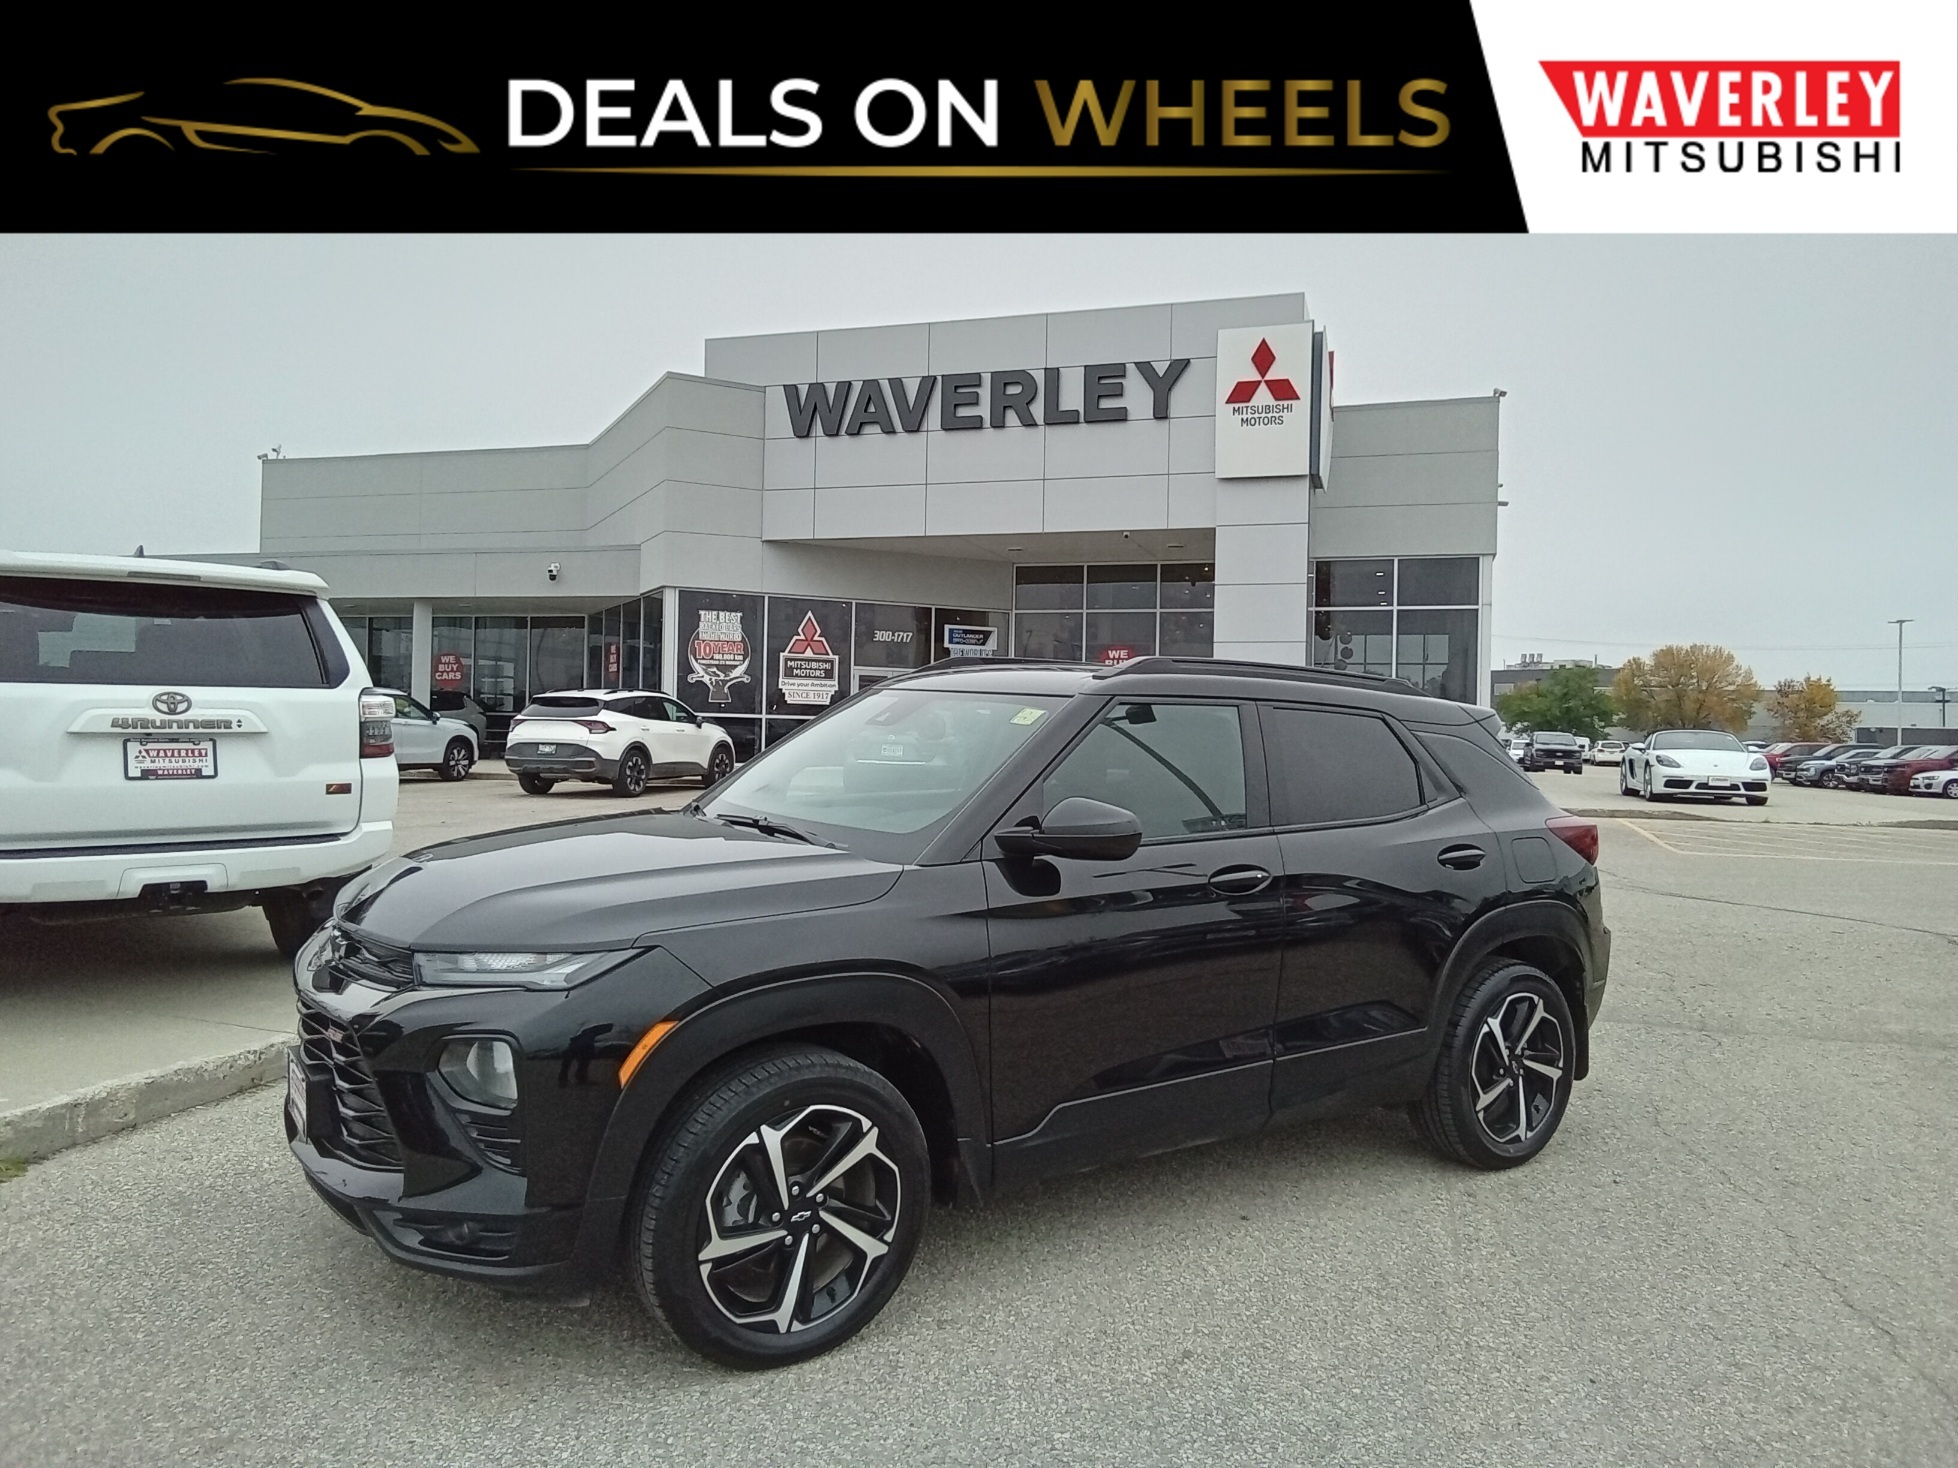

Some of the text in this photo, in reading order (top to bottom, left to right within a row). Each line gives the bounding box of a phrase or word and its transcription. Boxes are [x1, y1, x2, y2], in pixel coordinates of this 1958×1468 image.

[783, 358, 1190, 438] WAVERLEY
[1232, 403, 1293, 416] MITSUBISHI
[1240, 415, 1284, 427] MOTORS
[699, 610, 743, 624] THE BEST
[873, 630, 913, 643] 300-1717
[695, 640, 744, 659] 10 YEAR
[1108, 650, 1128, 659] WE
[441, 655, 456, 663] WE
[787, 660, 832, 669] MITSUBISHI
[435, 672, 462, 680] CARS
[793, 669, 825, 677] MOTORS
[812, 692, 829, 700] 1917
[111, 717, 233, 730] 4RUNNER
[149, 749, 207, 757] WAVERLEY
